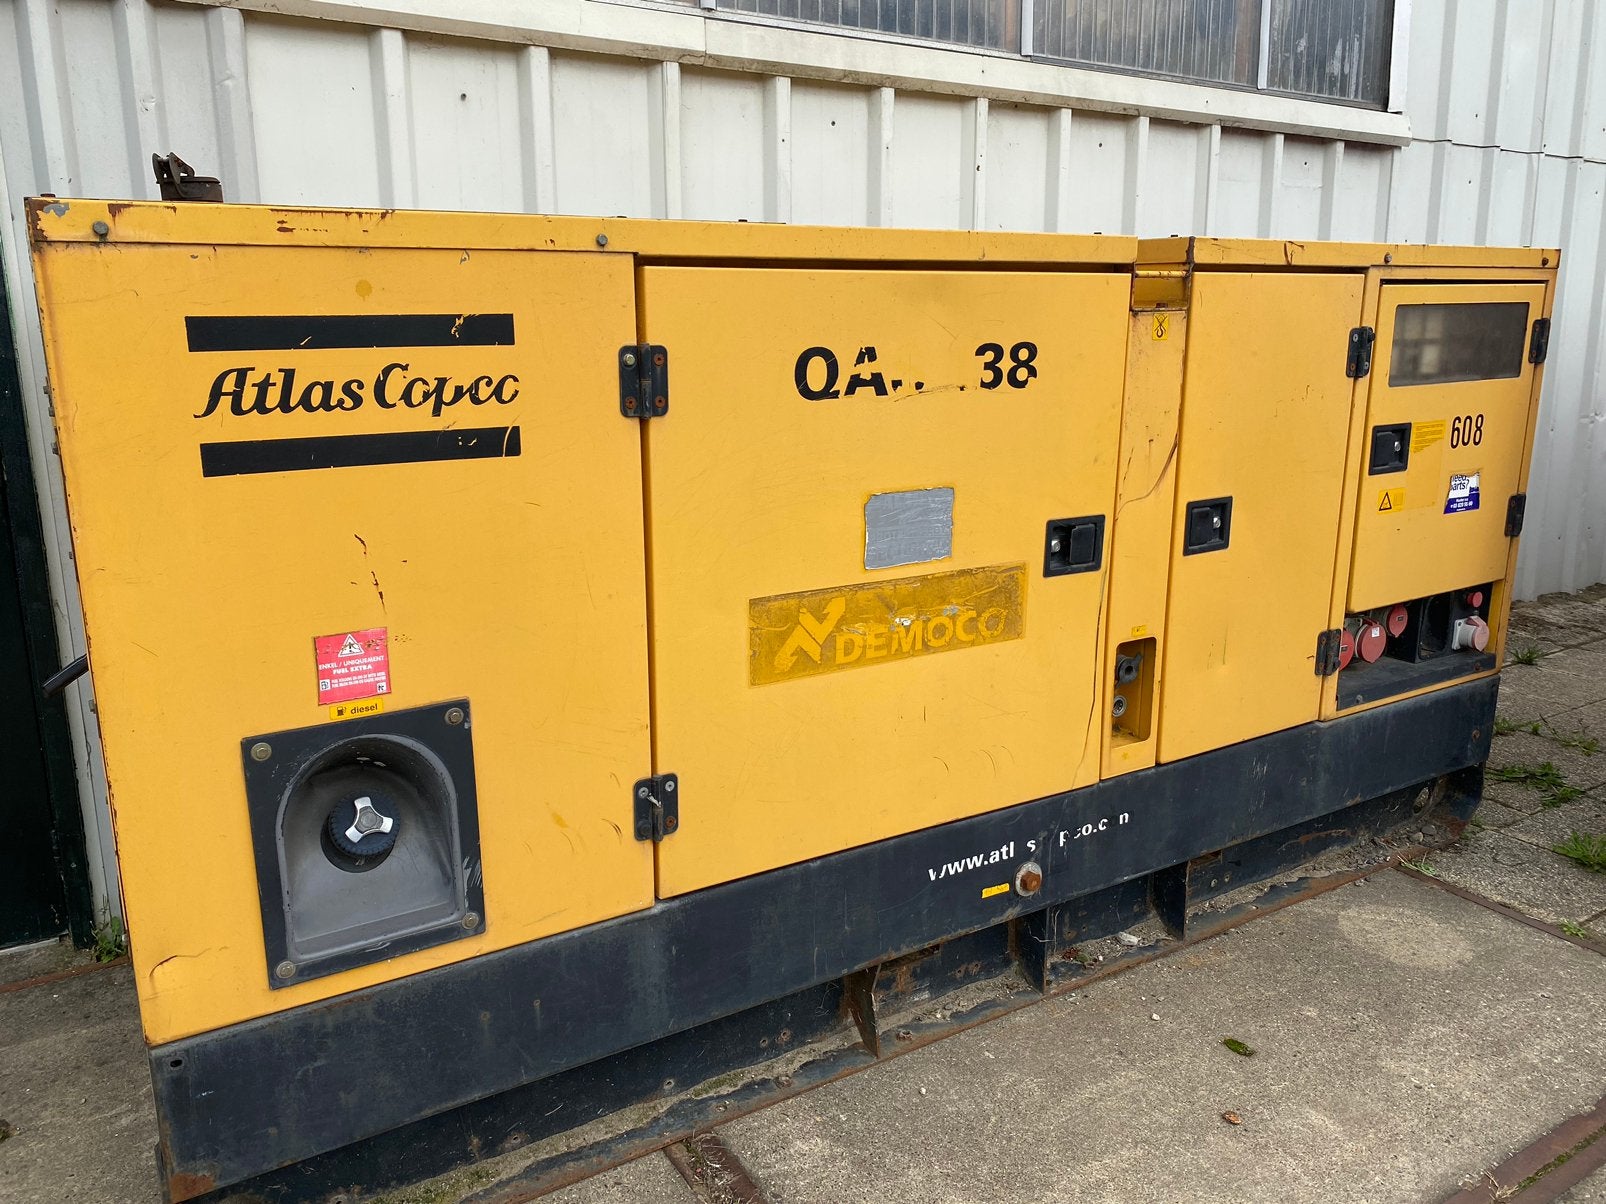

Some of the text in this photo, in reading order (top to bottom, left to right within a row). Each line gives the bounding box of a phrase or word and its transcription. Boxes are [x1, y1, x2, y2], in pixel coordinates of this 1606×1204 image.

[794, 341, 1038, 402] QA 38
[193, 362, 520, 419] Atlas Copco
[1450, 413, 1484, 449] 608
[835, 607, 1008, 665] DEMOCO
[319, 662, 338, 671] ENKEL
[343, 655, 385, 666] UNIQUEMENT
[332, 664, 373, 675] FUEL EXTRA
[350, 703, 378, 715] diesel
